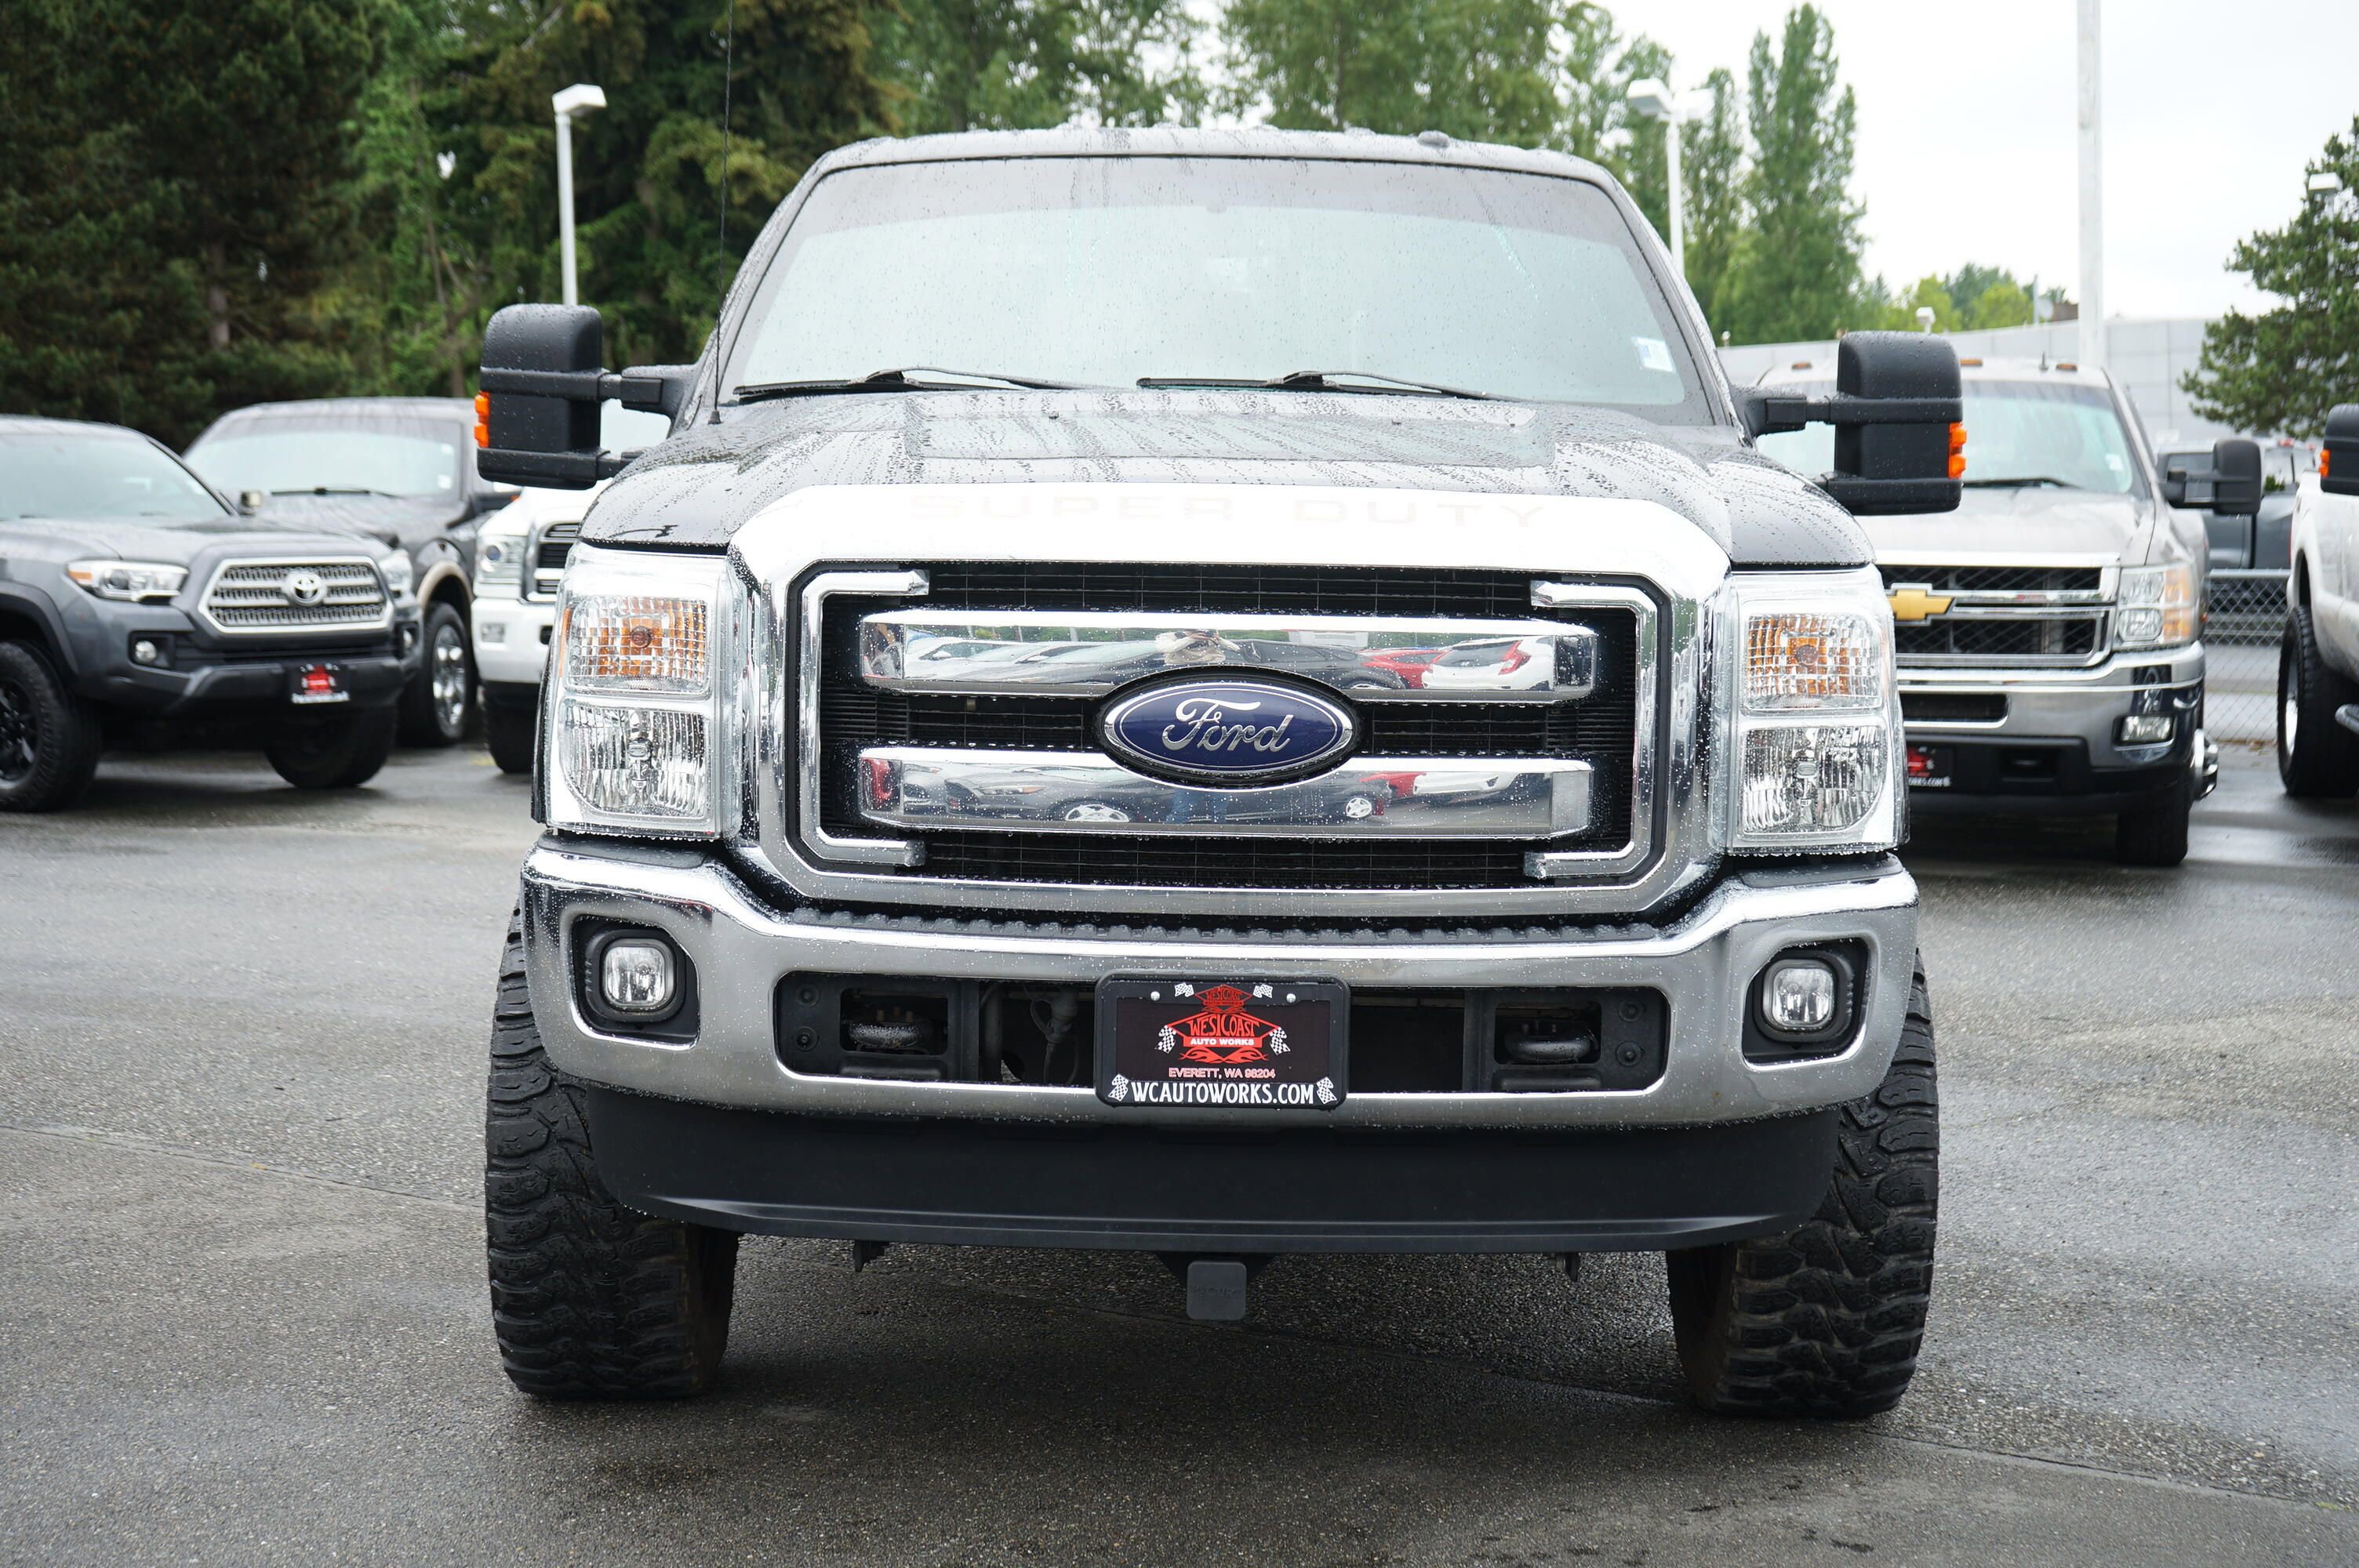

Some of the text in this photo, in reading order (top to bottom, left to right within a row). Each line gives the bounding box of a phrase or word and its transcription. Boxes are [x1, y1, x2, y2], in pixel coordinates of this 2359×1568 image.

[910, 494, 1544, 528] SUPER DUTY
[1162, 698, 1294, 752] Ford
[1169, 1067, 1276, 1079] EVERETT, WA 98204
[1131, 1082, 1314, 1105] WCAUTOWORKS.COM
